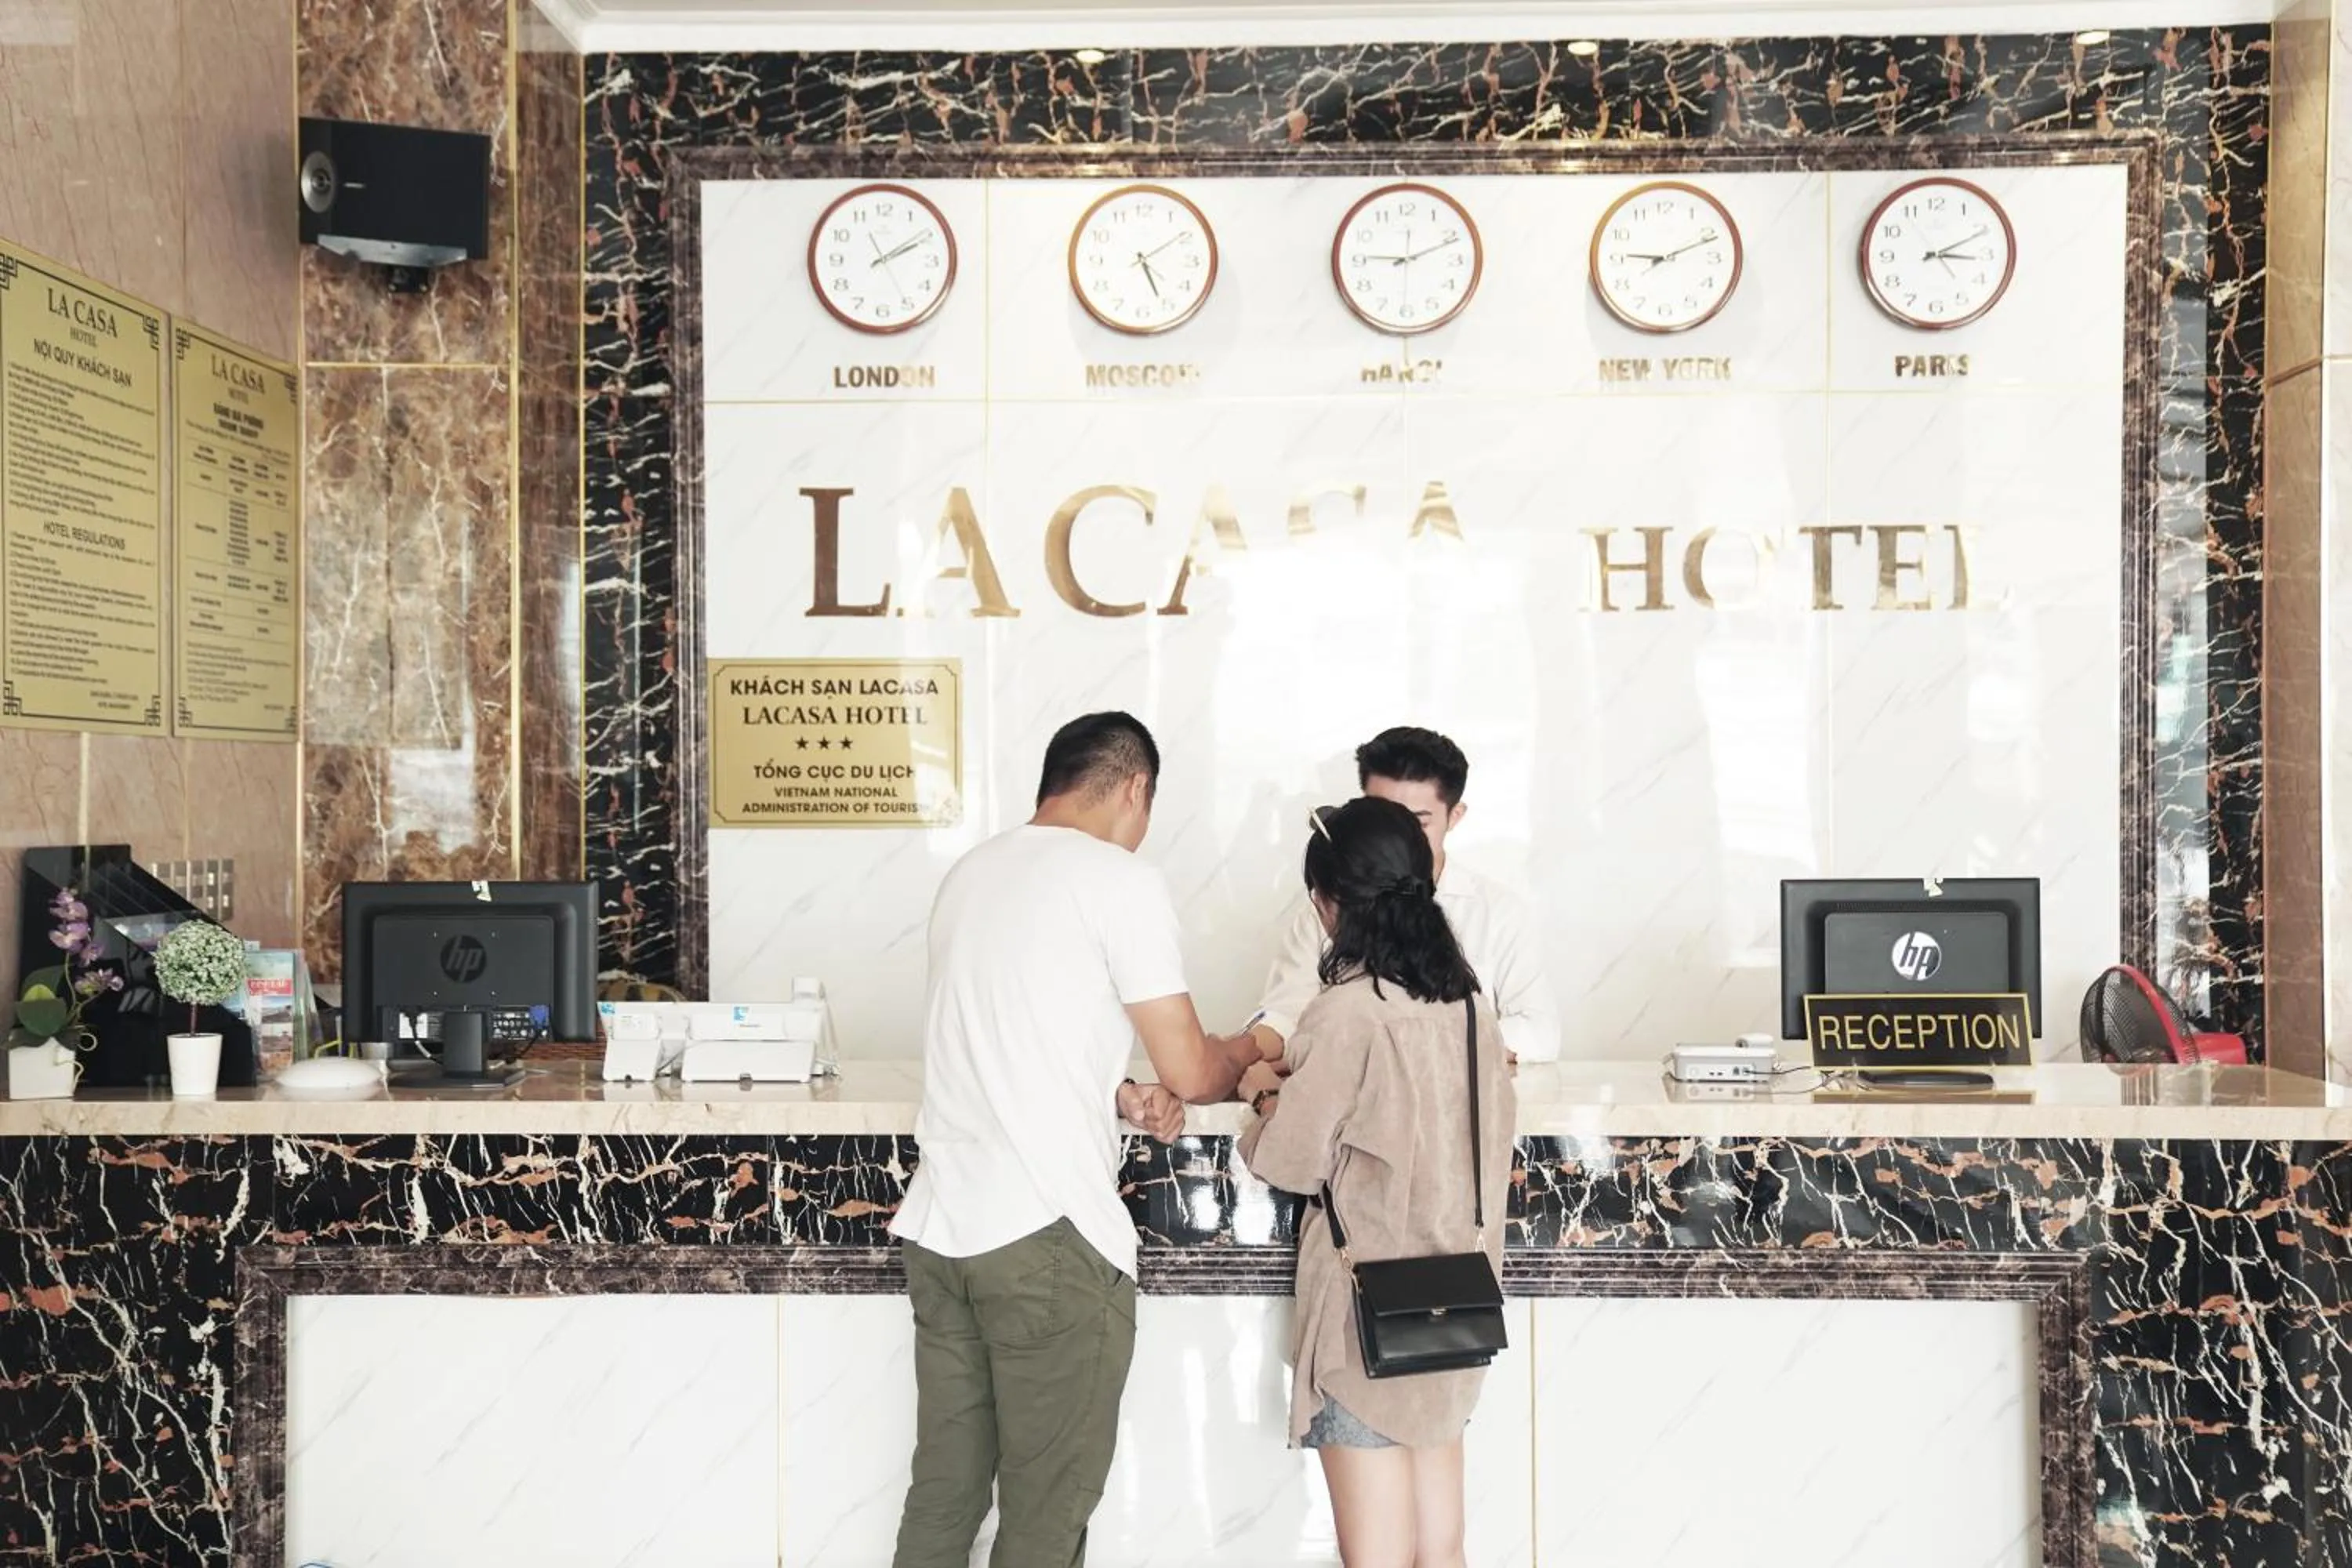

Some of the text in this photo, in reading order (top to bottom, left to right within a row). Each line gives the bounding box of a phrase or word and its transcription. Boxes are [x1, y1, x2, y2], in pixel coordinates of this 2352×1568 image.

[876, 203, 893, 216] 12
[1136, 204, 1153, 218] 12
[1399, 202, 1415, 216] 12
[1657, 201, 1674, 214] 12
[1928, 197, 1945, 211] 12
[1962, 202, 1966, 216] 1
[853, 210, 866, 223] 11
[908, 210, 913, 222] 1
[1113, 210, 1126, 223] 11
[1168, 210, 1173, 223] 1
[1376, 210, 1388, 223] 11
[1431, 209, 1436, 222] 1
[1634, 208, 1646, 220] 11
[1690, 208, 1694, 220] 1
[1904, 205, 1918, 219] 11
[833, 228, 851, 243] 10
[1356, 229, 1373, 243] 10
[1613, 228, 1630, 241] 10
[1884, 225, 1901, 238] 10
[829, 253, 844, 267] 9
[925, 254, 939, 267] 3
[1186, 254, 1200, 267] 3
[1352, 253, 1367, 267] 9
[1449, 253, 1463, 267] 3
[1610, 253, 1624, 265] 9
[1708, 252, 1722, 264] 3
[1879, 249, 1895, 263] 9
[1980, 247, 1994, 261] 3
[833, 278, 849, 292] 8
[918, 279, 931, 292] 4
[1178, 279, 1190, 292] 4
[1356, 278, 1372, 292] 8
[1442, 278, 1454, 291] 4
[1700, 277, 1713, 289] 4
[1884, 274, 1900, 288] 8
[1973, 272, 1985, 285] 4
[852, 296, 865, 310] 7
[901, 297, 915, 310] 5
[1112, 298, 1123, 310] 7
[1376, 297, 1388, 311] 7
[1425, 296, 1439, 310] 5
[1632, 296, 1646, 310] 7
[1684, 295, 1697, 309] 5
[1904, 293, 1917, 307] 7
[1955, 292, 1969, 306] 5
[47, 287, 118, 339] LA CASA
[875, 304, 890, 318] 6
[1399, 303, 1414, 318] 6
[1658, 303, 1672, 316] 6
[1929, 300, 1944, 314] 6
[211, 353, 265, 394] LA CASA
[834, 365, 935, 388] LONDON
[1599, 358, 1731, 382] NEW YORK
[43, 521, 71, 539] HOTEL
[731, 675, 938, 699] KHÁCH SẠN LACASA
[743, 706, 928, 724] LACASA HOTEL
[753, 758, 801, 779] TỔNG
[807, 765, 846, 782] CỤC
[851, 765, 873, 779] DU
[774, 787, 898, 797] VIETNAM NATIONAL
[742, 803, 926, 813] ADMINISTRATION OF TOURIS
[441, 935, 487, 982] hp
[1892, 931, 1942, 981] hp
[1817, 1014, 2020, 1050] RECEPTION
